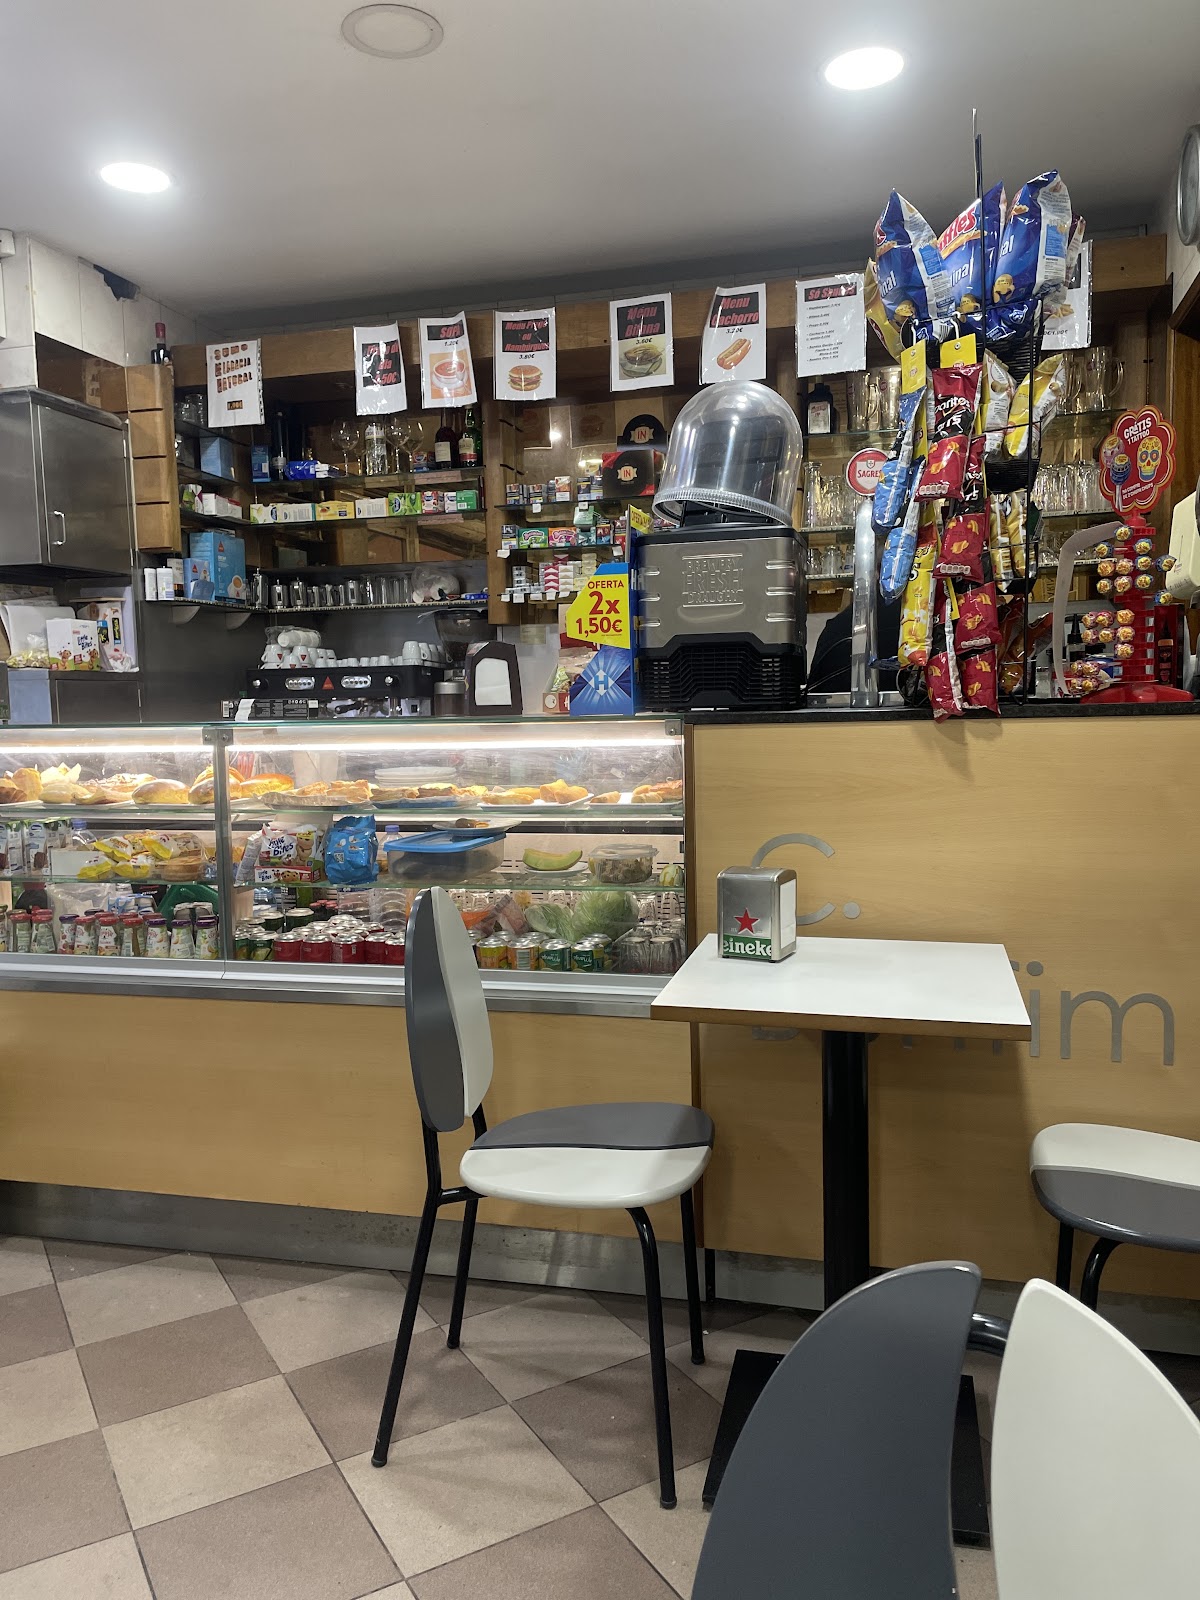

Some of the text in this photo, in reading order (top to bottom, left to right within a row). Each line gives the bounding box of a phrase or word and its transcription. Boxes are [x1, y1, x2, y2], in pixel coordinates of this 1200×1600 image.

[721, 297, 750, 310] Menu
[627, 306, 657, 320] Menu
[711, 312, 758, 326] Cachorro
[505, 321, 526, 331] Menu
[638, 430, 647, 440] IN
[1123, 417, 1152, 440] GRÁTIS
[1131, 429, 1150, 444] TATTOO
[623, 469, 631, 478] IN
[587, 580, 624, 590] OFERTA
[589, 591, 621, 615] 2x
[576, 616, 623, 638] 1,50€
